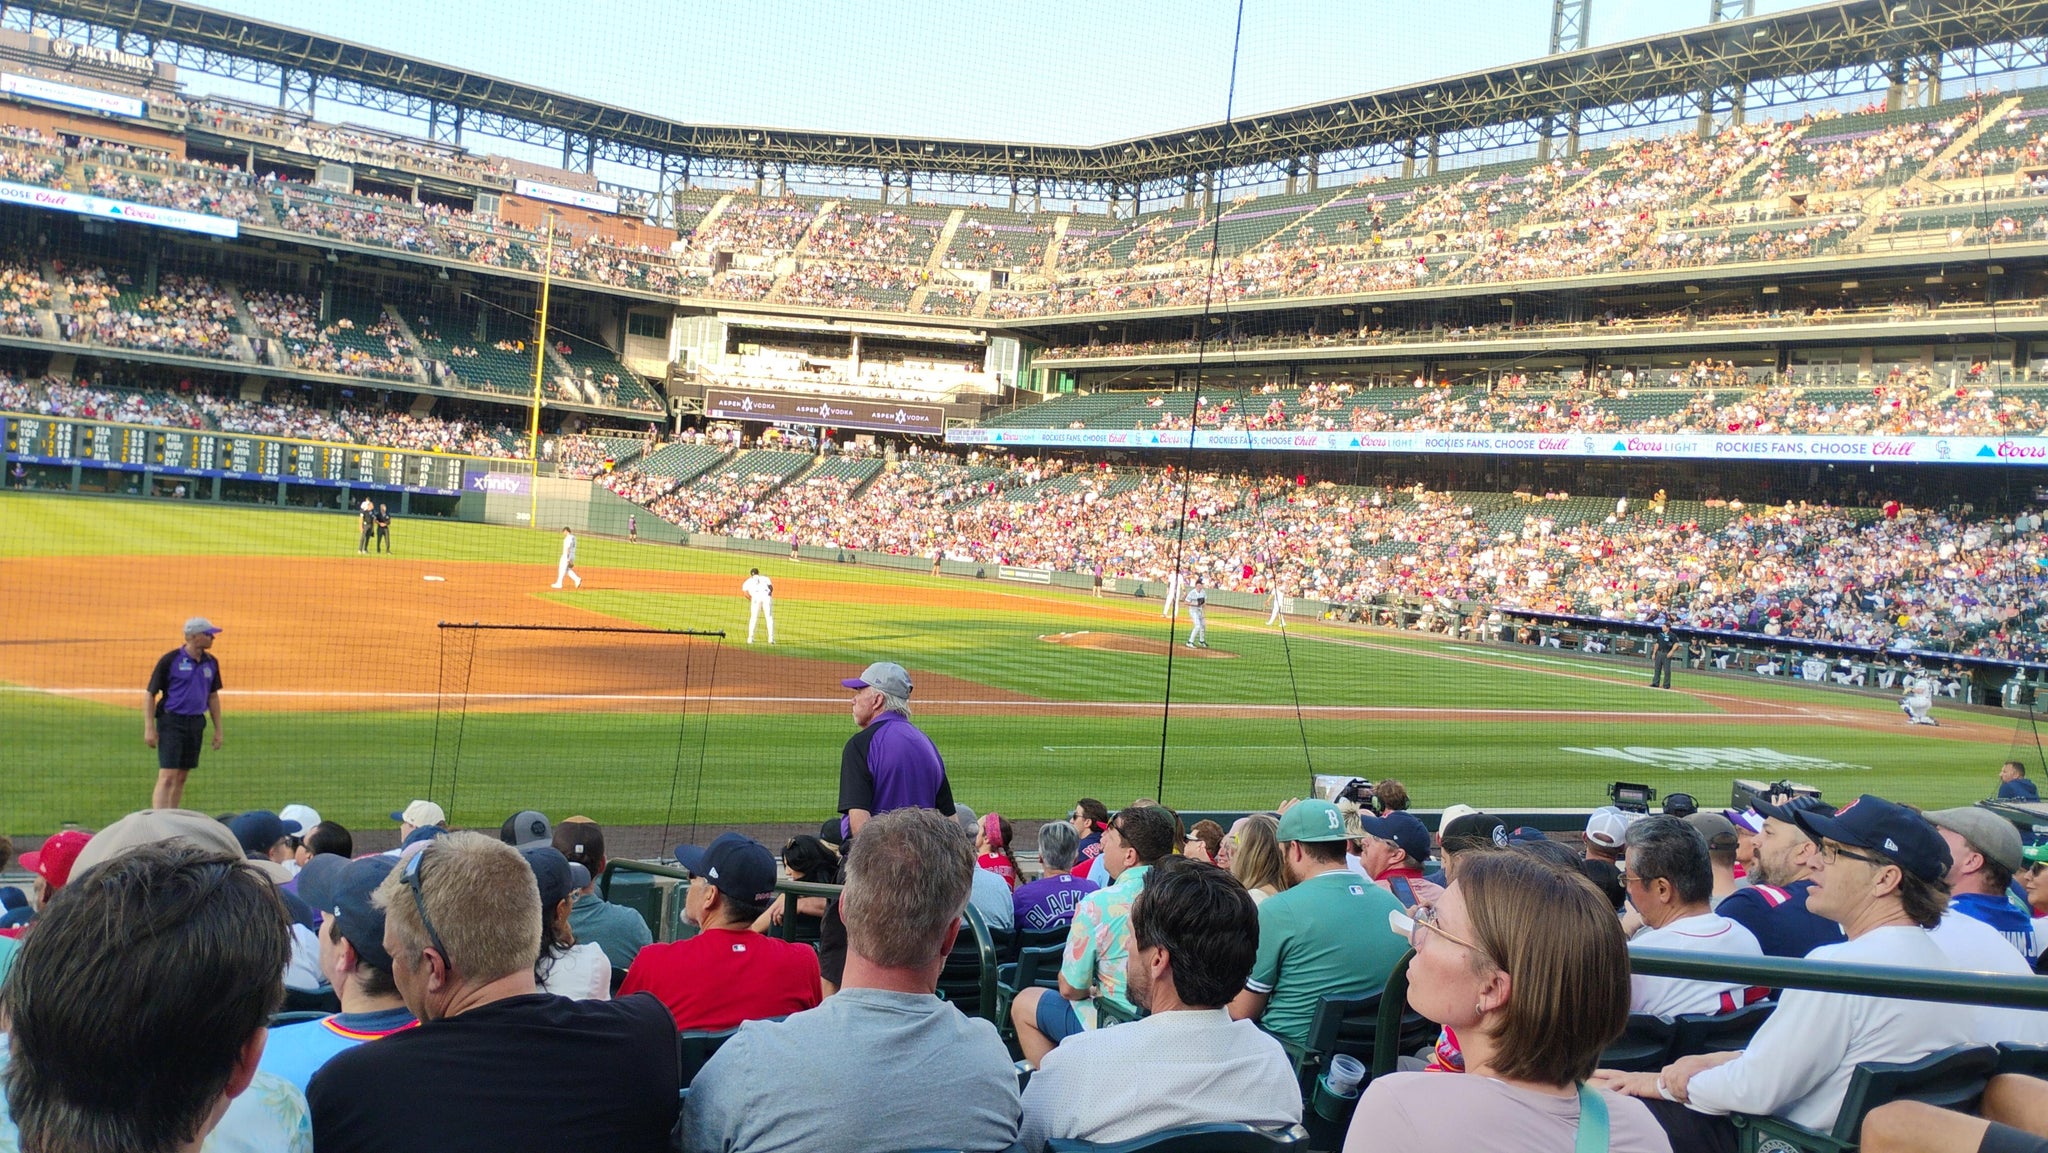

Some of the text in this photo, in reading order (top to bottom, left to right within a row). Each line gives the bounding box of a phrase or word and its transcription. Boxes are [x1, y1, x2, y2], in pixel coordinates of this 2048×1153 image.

[77, 44, 154, 70] JACK DANIEL'S
[36, 191, 68, 206] Chill
[124, 206, 156, 221] Coors
[511, 231, 528, 240] LIGHT
[719, 399, 776, 410] ASPEN VODKA
[796, 405, 853, 416] ASPEN VODKA
[871, 411, 895, 419] ASPEN
[20, 419, 39, 430] HOU
[20, 428, 37, 438] TOR
[95, 426, 111, 436] SEA
[19, 437, 30, 447] KC
[1108, 433, 1128, 443] Chill
[1208, 436, 1239, 445] ROCKIES
[1260, 436, 1292, 446] CHOOSE
[1293, 435, 1317, 447] Chill
[1360, 435, 1386, 447] Coors
[1425, 438, 1464, 448] ROCKIES
[1494, 439, 1535, 449] CHOOSE
[1538, 438, 1570, 450] Chill
[1627, 437, 1698, 452] Coors LIGHT
[1715, 441, 1768, 453] ROCKIES
[1810, 443, 1867, 455] CHOOSE
[1872, 441, 1916, 456] Chill
[1997, 441, 2046, 457] Coors
[19, 446, 29, 455] TB
[299, 446, 314, 455] LAD
[420, 456, 432, 466] ATL
[298, 462, 311, 470] CLE
[329, 464, 342, 473] 77
[360, 475, 374, 483] LAA
[473, 474, 520, 494] xfinity
[1324, 809, 1340, 830] B
[1026, 890, 1091, 930] BLACK
